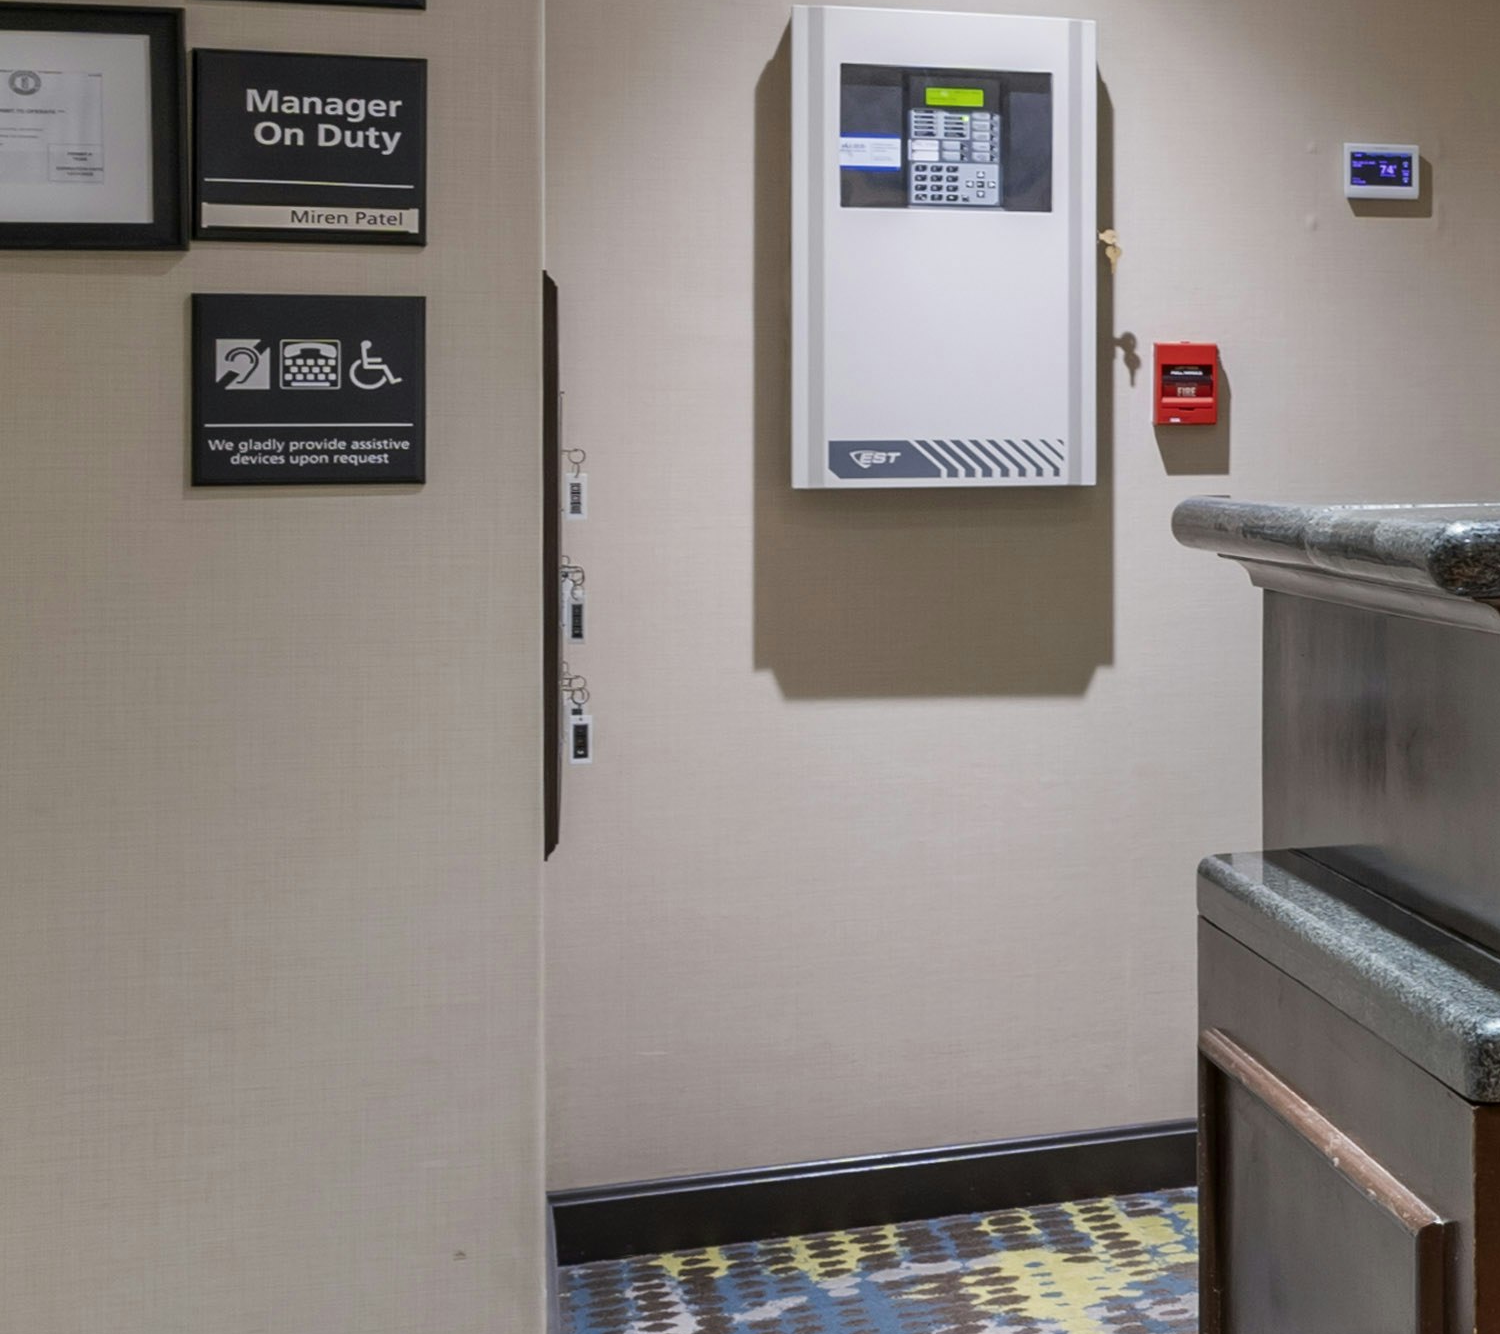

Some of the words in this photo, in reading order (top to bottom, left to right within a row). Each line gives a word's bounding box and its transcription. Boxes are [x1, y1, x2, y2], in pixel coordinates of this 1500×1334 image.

[246, 88, 403, 123] Manager
[254, 121, 304, 146] On
[318, 123, 402, 155] Duty
[290, 210, 348, 225] Miren
[355, 211, 403, 226] Patel
[1177, 386, 1198, 397] FIRE
[208, 439, 234, 451] We
[238, 439, 285, 453] gladly
[289, 438, 347, 453] provide
[350, 438, 410, 450] assistive
[230, 453, 285, 465] devices
[289, 454, 329, 467] upon
[333, 453, 389, 467] request
